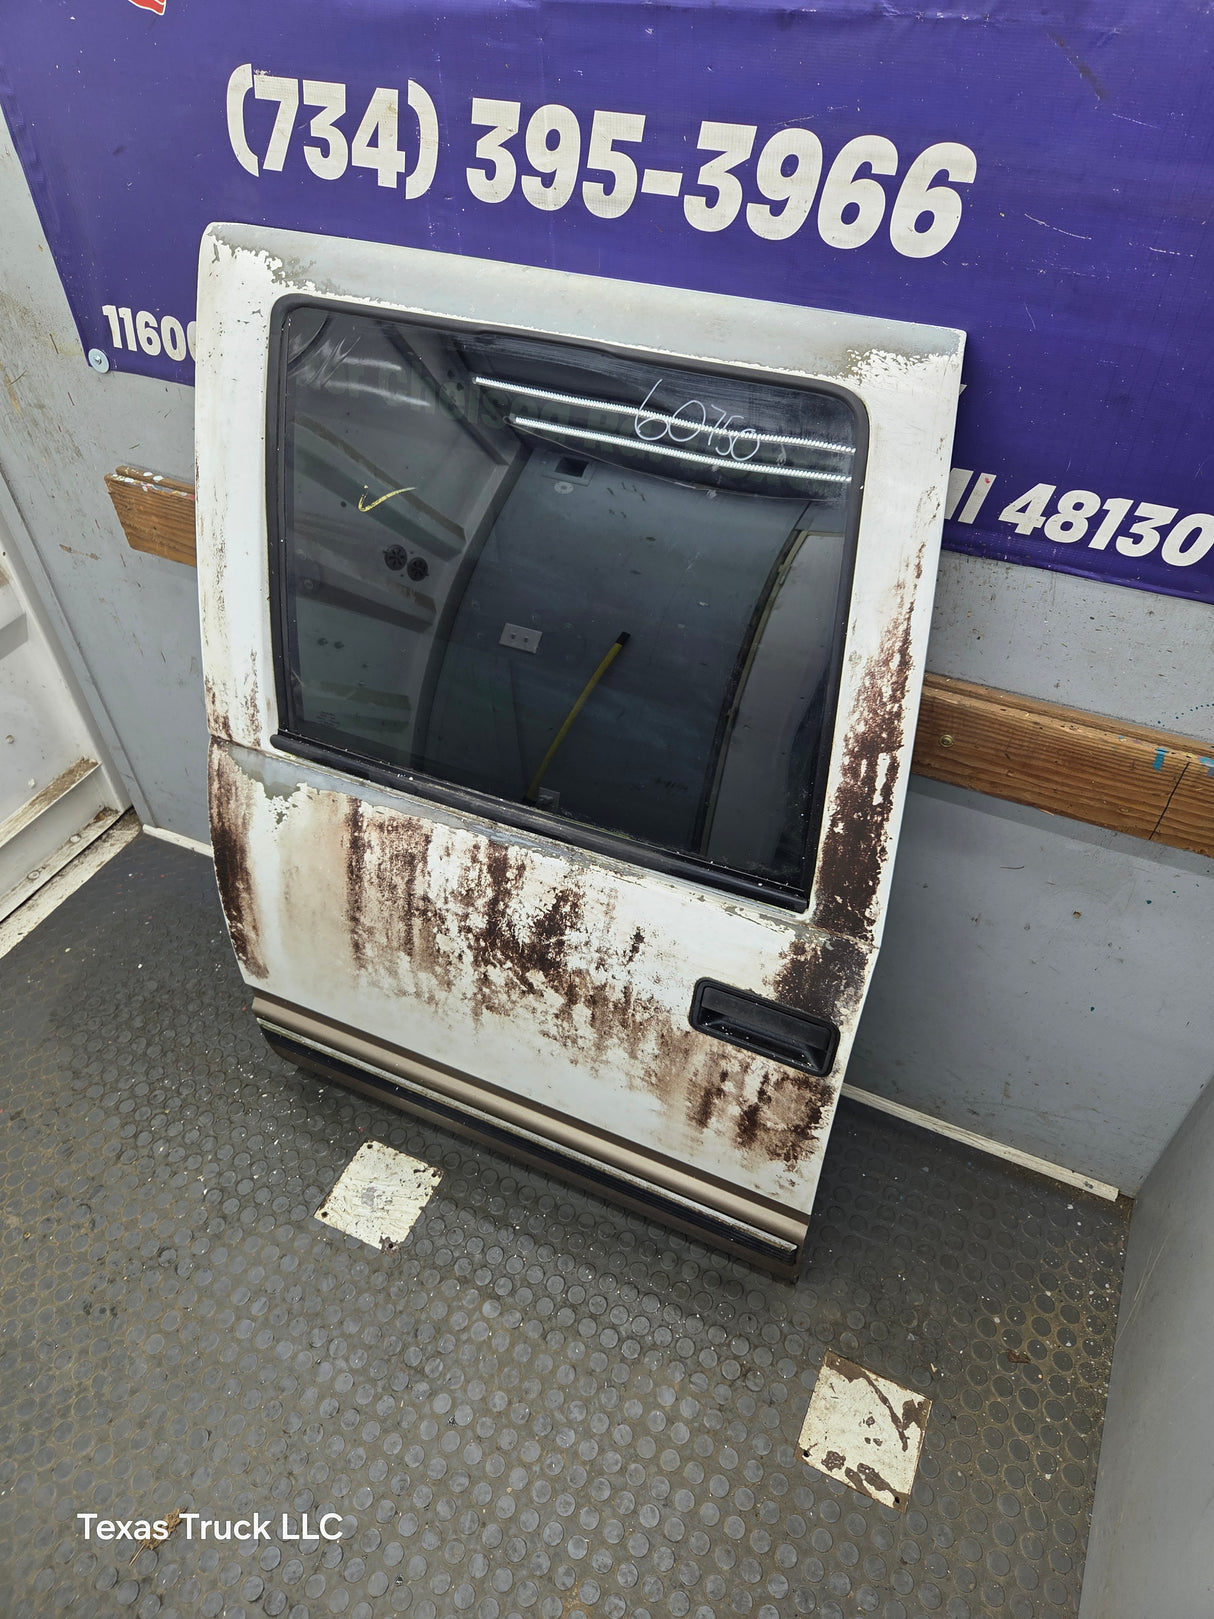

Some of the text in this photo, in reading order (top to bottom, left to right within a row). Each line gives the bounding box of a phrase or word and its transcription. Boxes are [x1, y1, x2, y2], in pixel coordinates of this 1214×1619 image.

[226, 63, 978, 258] (734) 395-3966
[635, 379, 760, 460] 60750
[998, 482, 1214, 567] 48130
